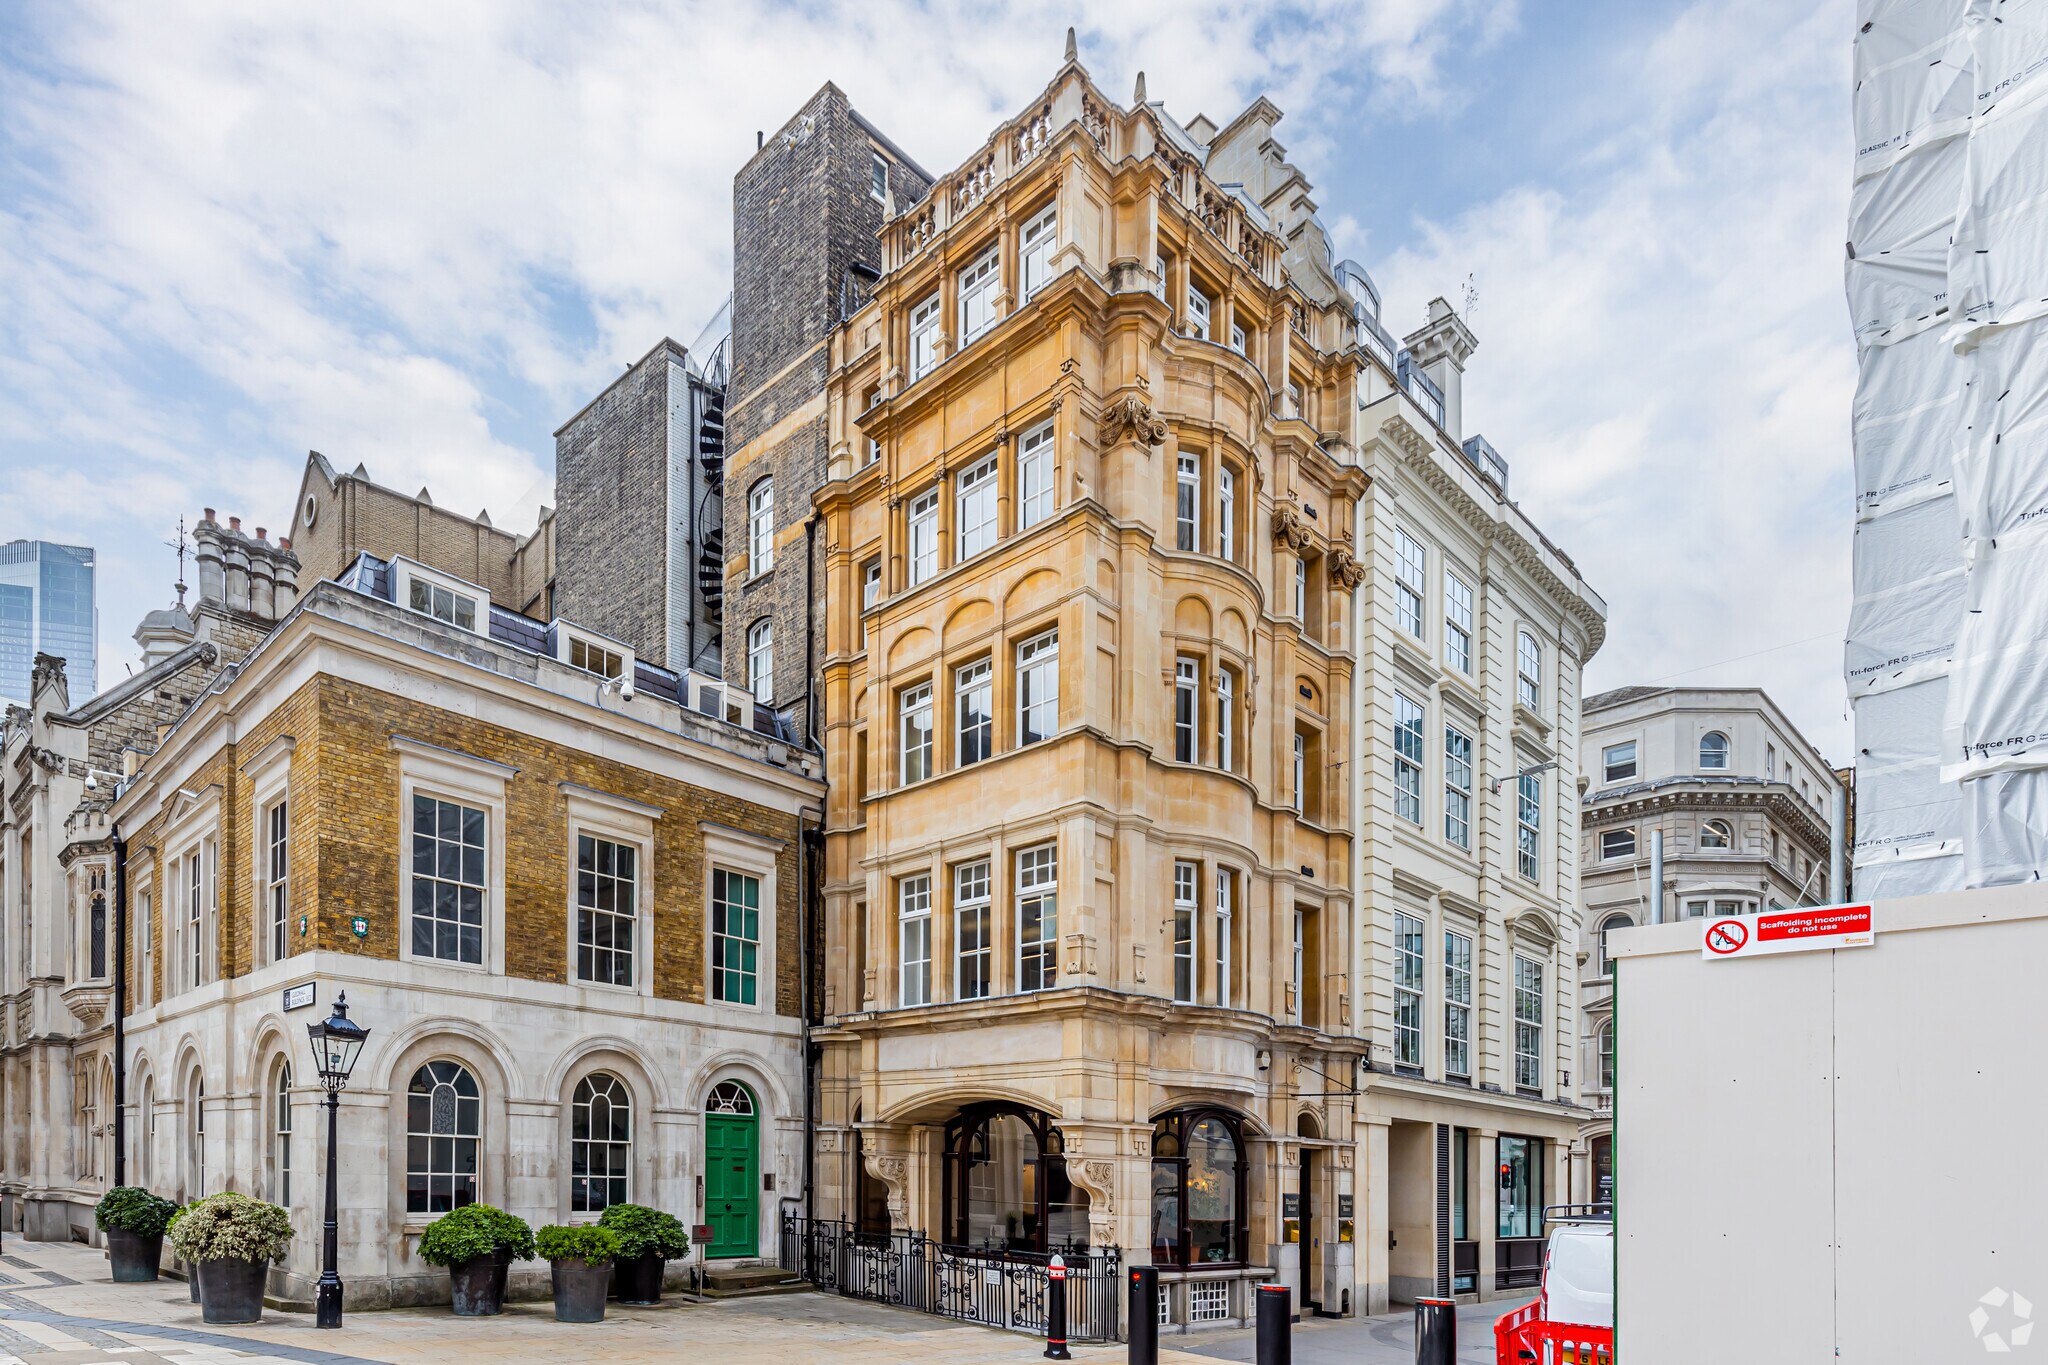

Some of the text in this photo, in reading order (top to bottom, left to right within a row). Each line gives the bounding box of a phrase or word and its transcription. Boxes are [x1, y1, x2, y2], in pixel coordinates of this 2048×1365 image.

[1860, 140, 1888, 155] CLASSIC
[1850, 657, 1900, 676] Tri-force FR
[2007, 737, 2023, 745] FR
[1760, 913, 1868, 929] Scaffolding incomplete
[1802, 925, 1818, 933] not
[1820, 923, 1838, 931] use
